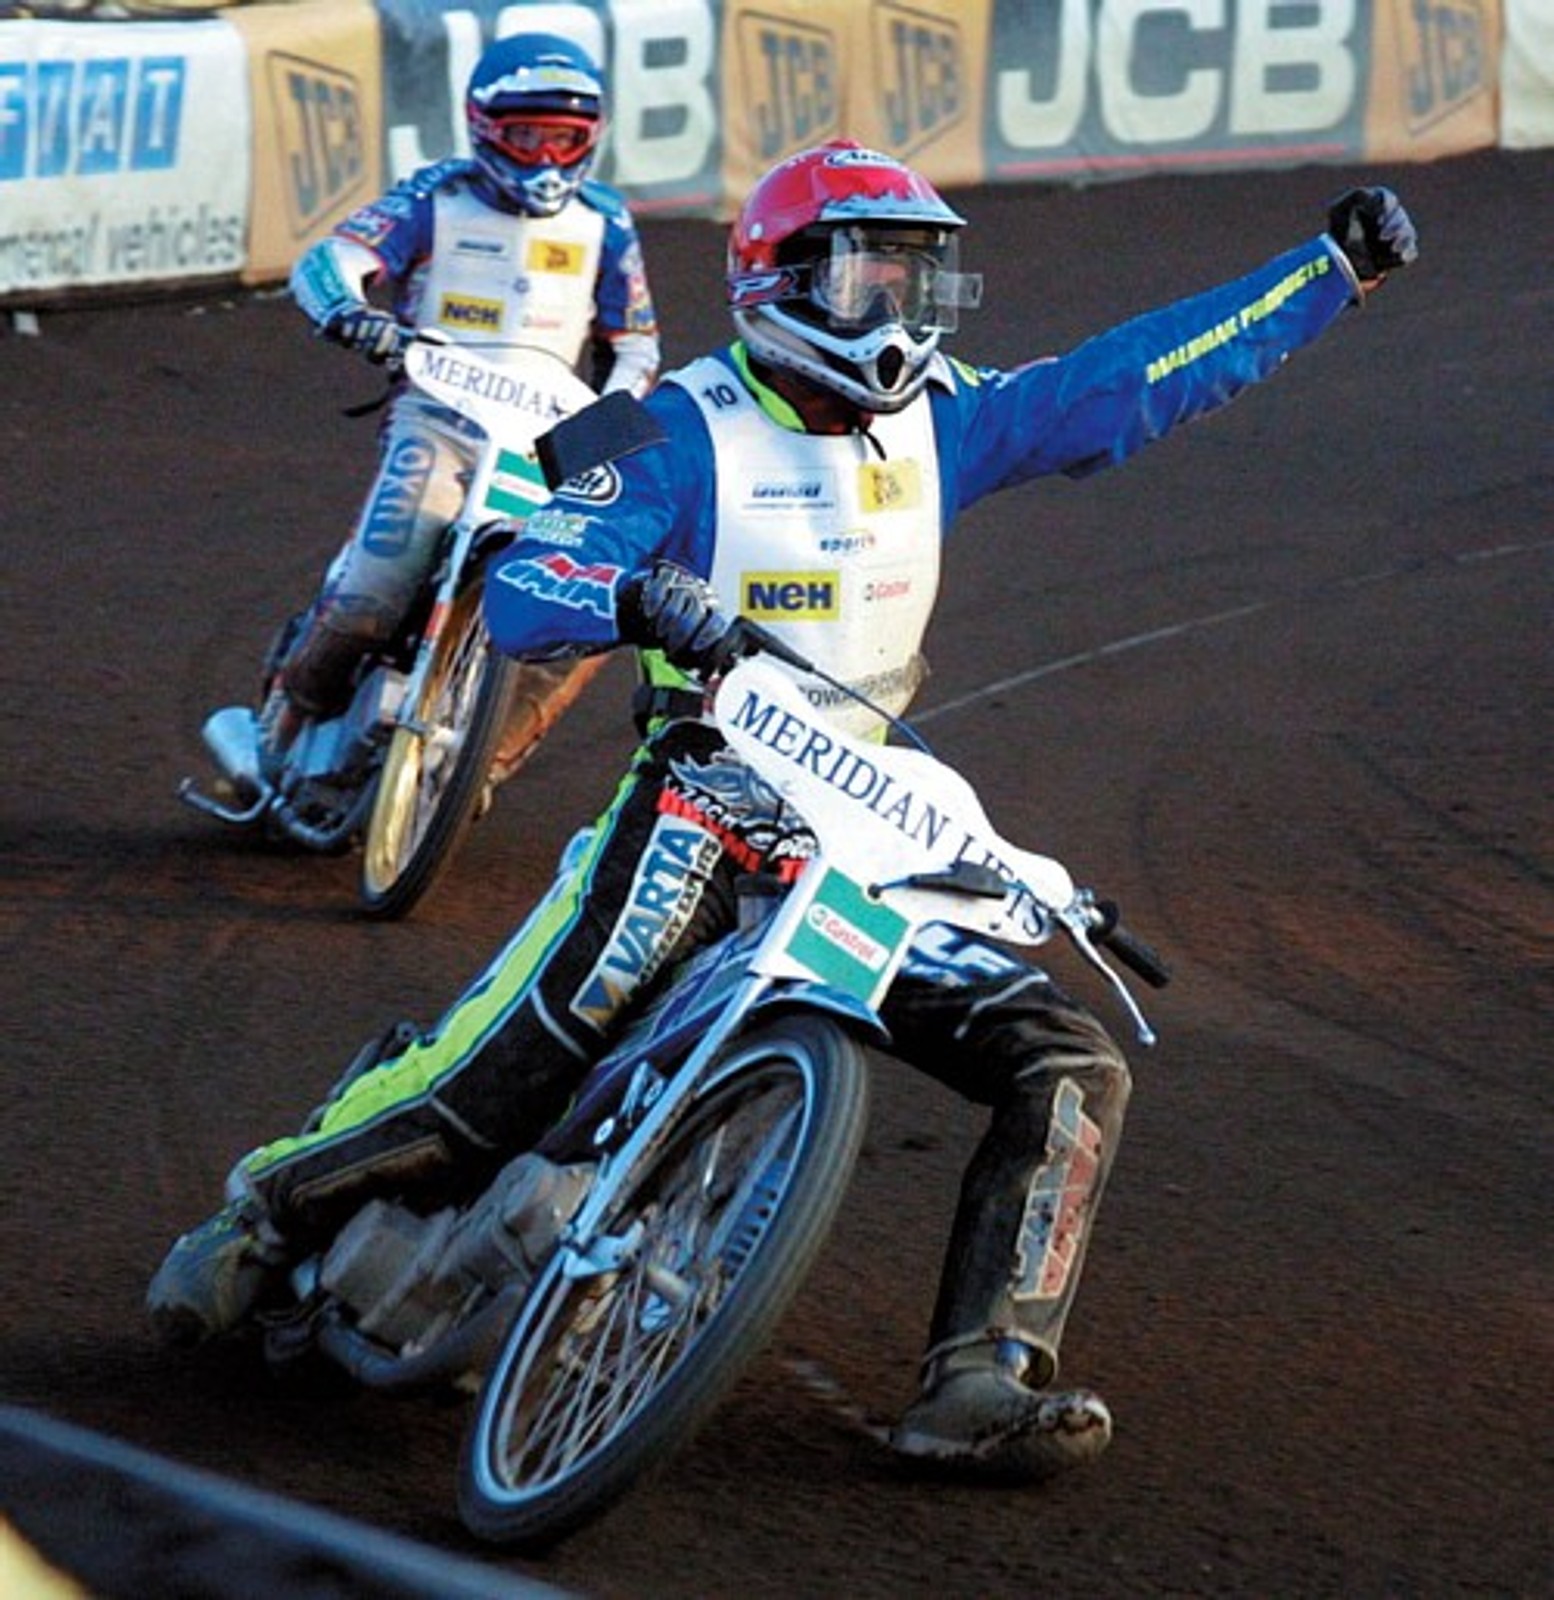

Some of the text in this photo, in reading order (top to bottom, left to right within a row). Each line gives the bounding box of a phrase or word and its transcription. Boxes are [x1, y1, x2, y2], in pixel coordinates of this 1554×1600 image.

[0, 62, 182, 170] FIAT
[756, 28, 832, 158] JCB
[883, 18, 960, 147] JCB
[997, 0, 1357, 149] JCB
[287, 70, 359, 219] JCB
[703, 384, 738, 409] 10
[730, 689, 951, 851] MERIDIAN
[604, 829, 706, 974] VARTA
